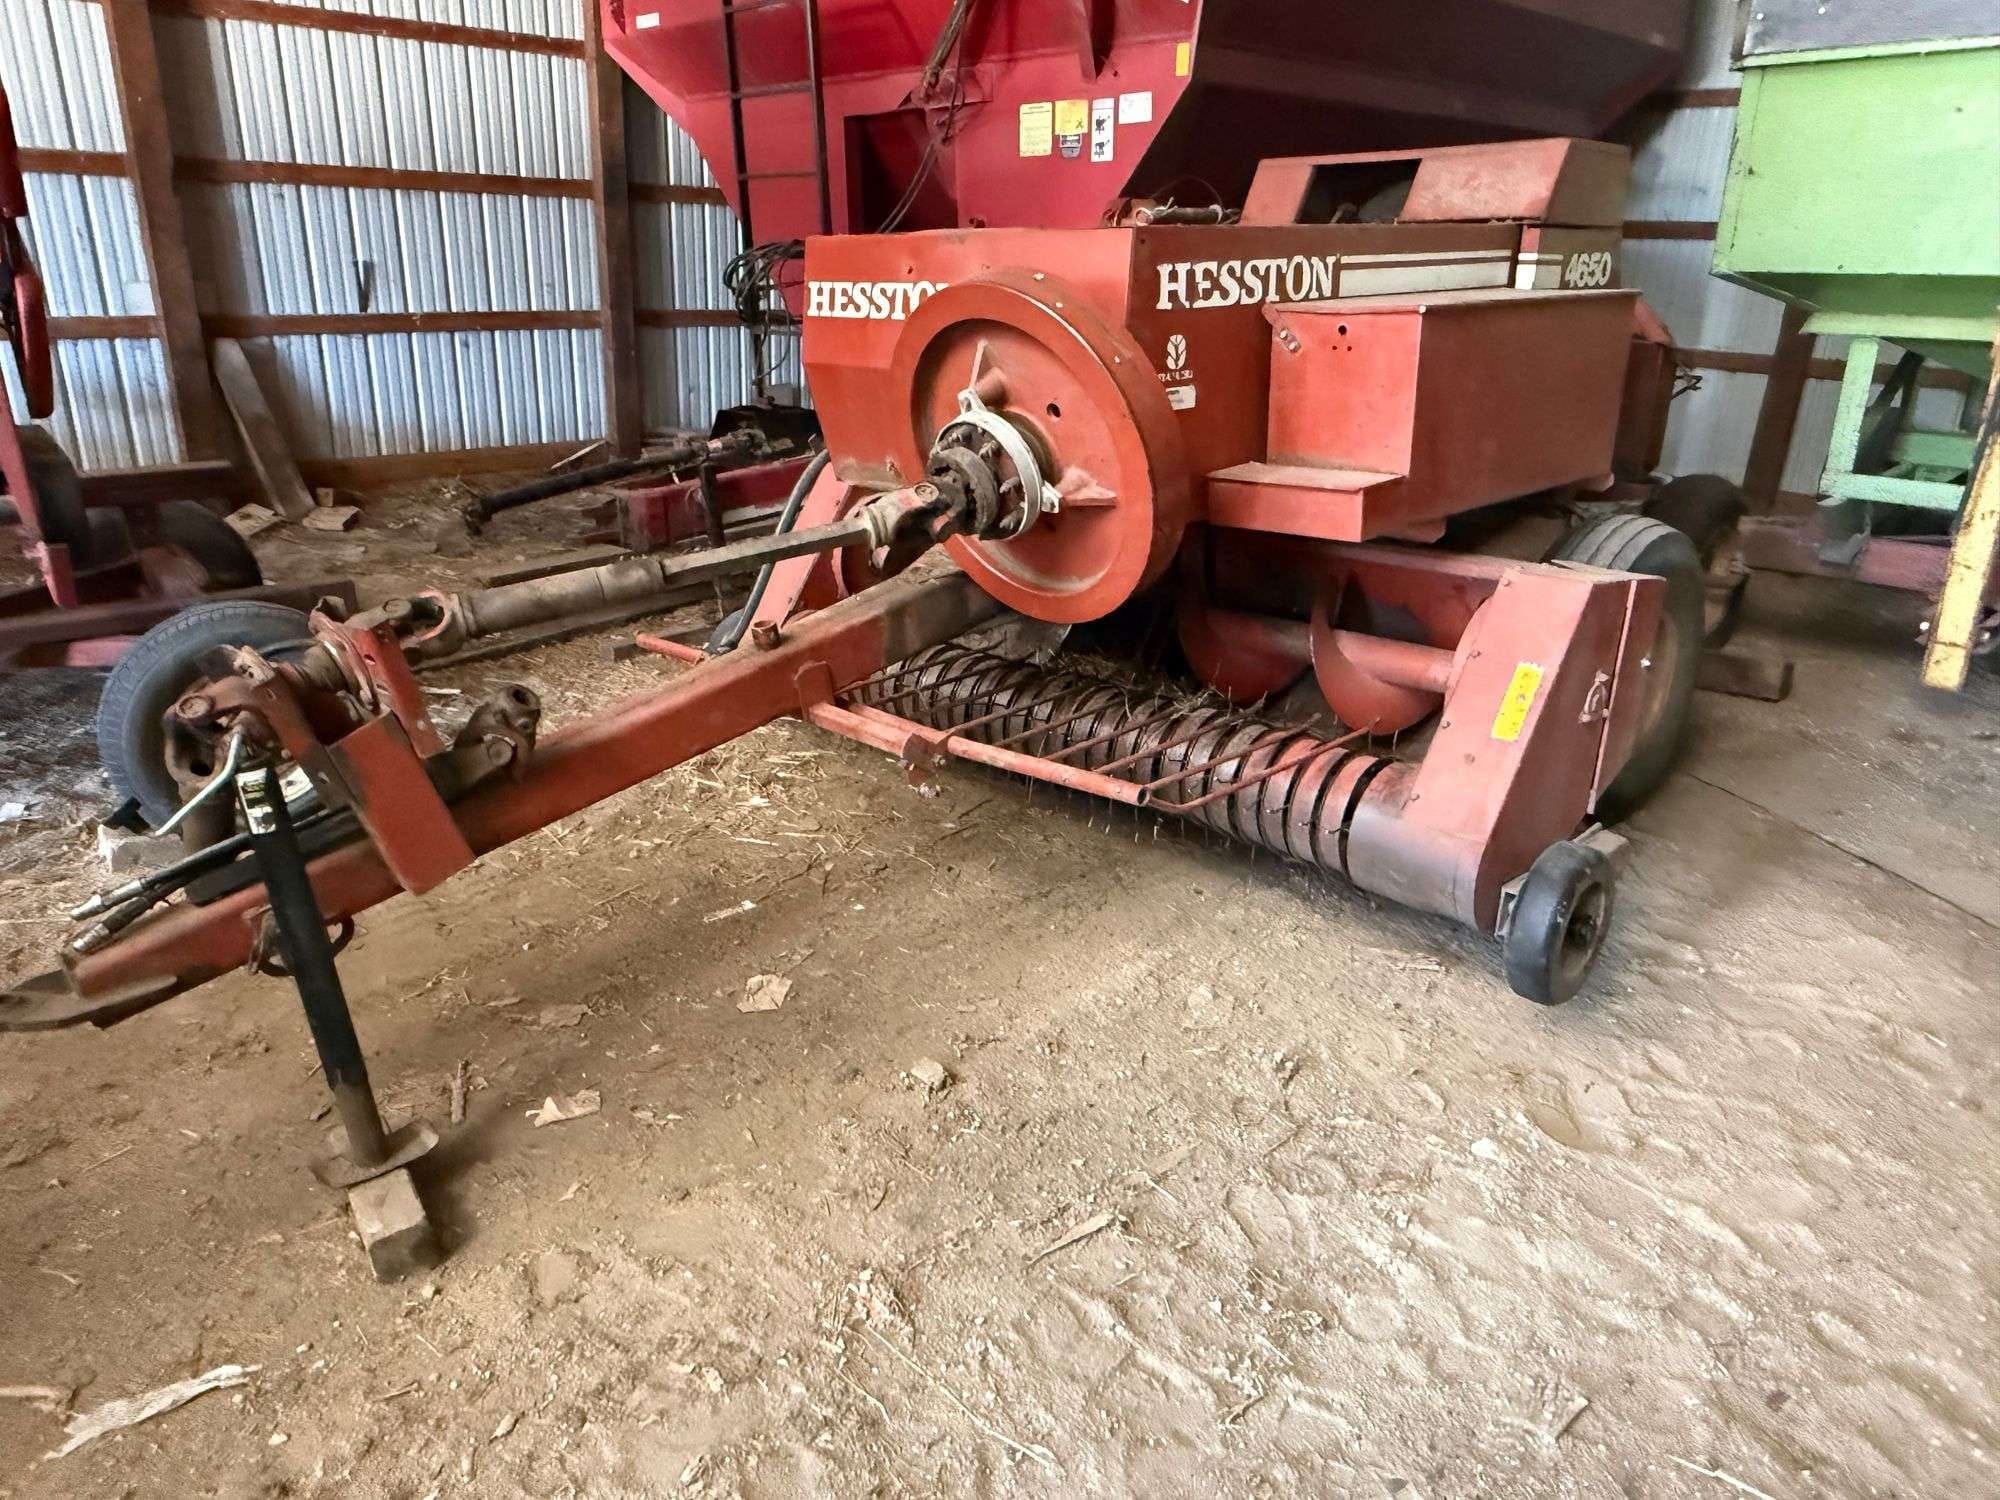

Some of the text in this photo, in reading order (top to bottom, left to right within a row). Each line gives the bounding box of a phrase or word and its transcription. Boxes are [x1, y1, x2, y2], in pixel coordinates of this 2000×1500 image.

[1156, 255, 1336, 310] HESSTON
[1565, 251, 1612, 288] 4650
[807, 281, 950, 321] HESSTO
